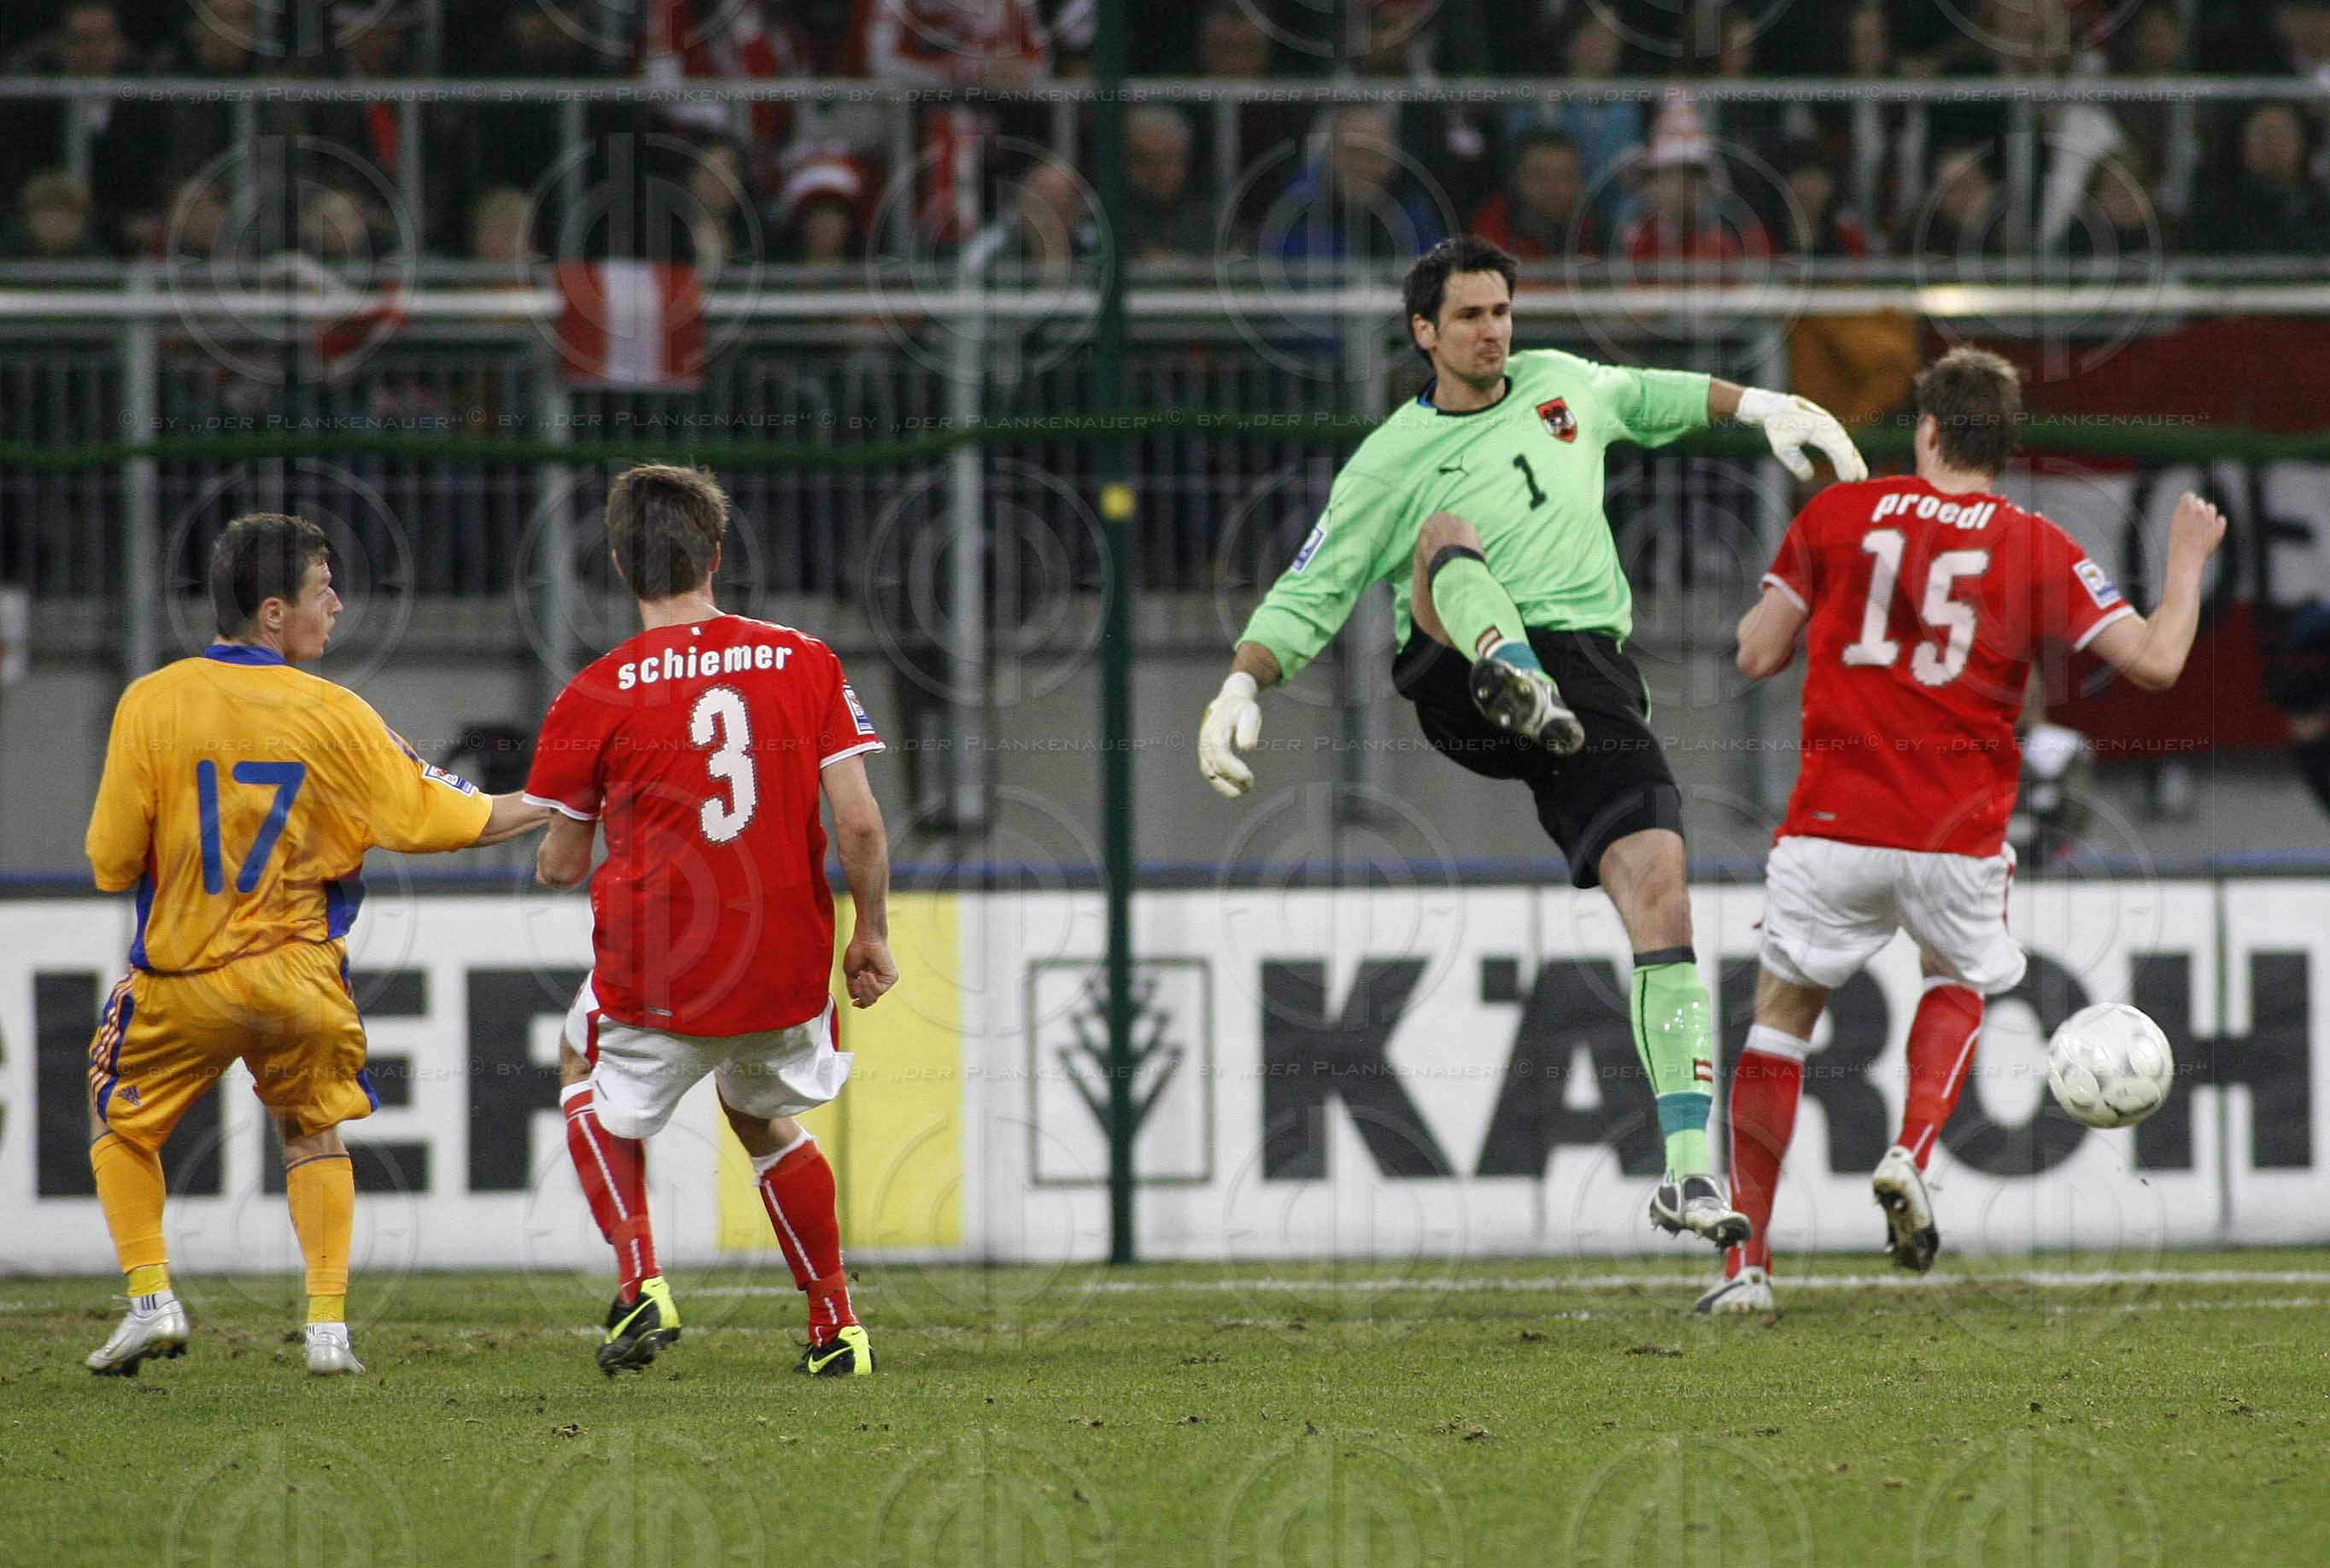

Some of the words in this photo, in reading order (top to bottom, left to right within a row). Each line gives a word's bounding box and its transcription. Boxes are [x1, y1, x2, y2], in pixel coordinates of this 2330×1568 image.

[1513, 453, 1547, 511] 1
[1871, 493, 1997, 530] proedl
[1841, 528, 1991, 687] 15
[618, 644, 793, 690] schiemer
[687, 685, 758, 845] 3
[196, 758, 307, 895] 17
